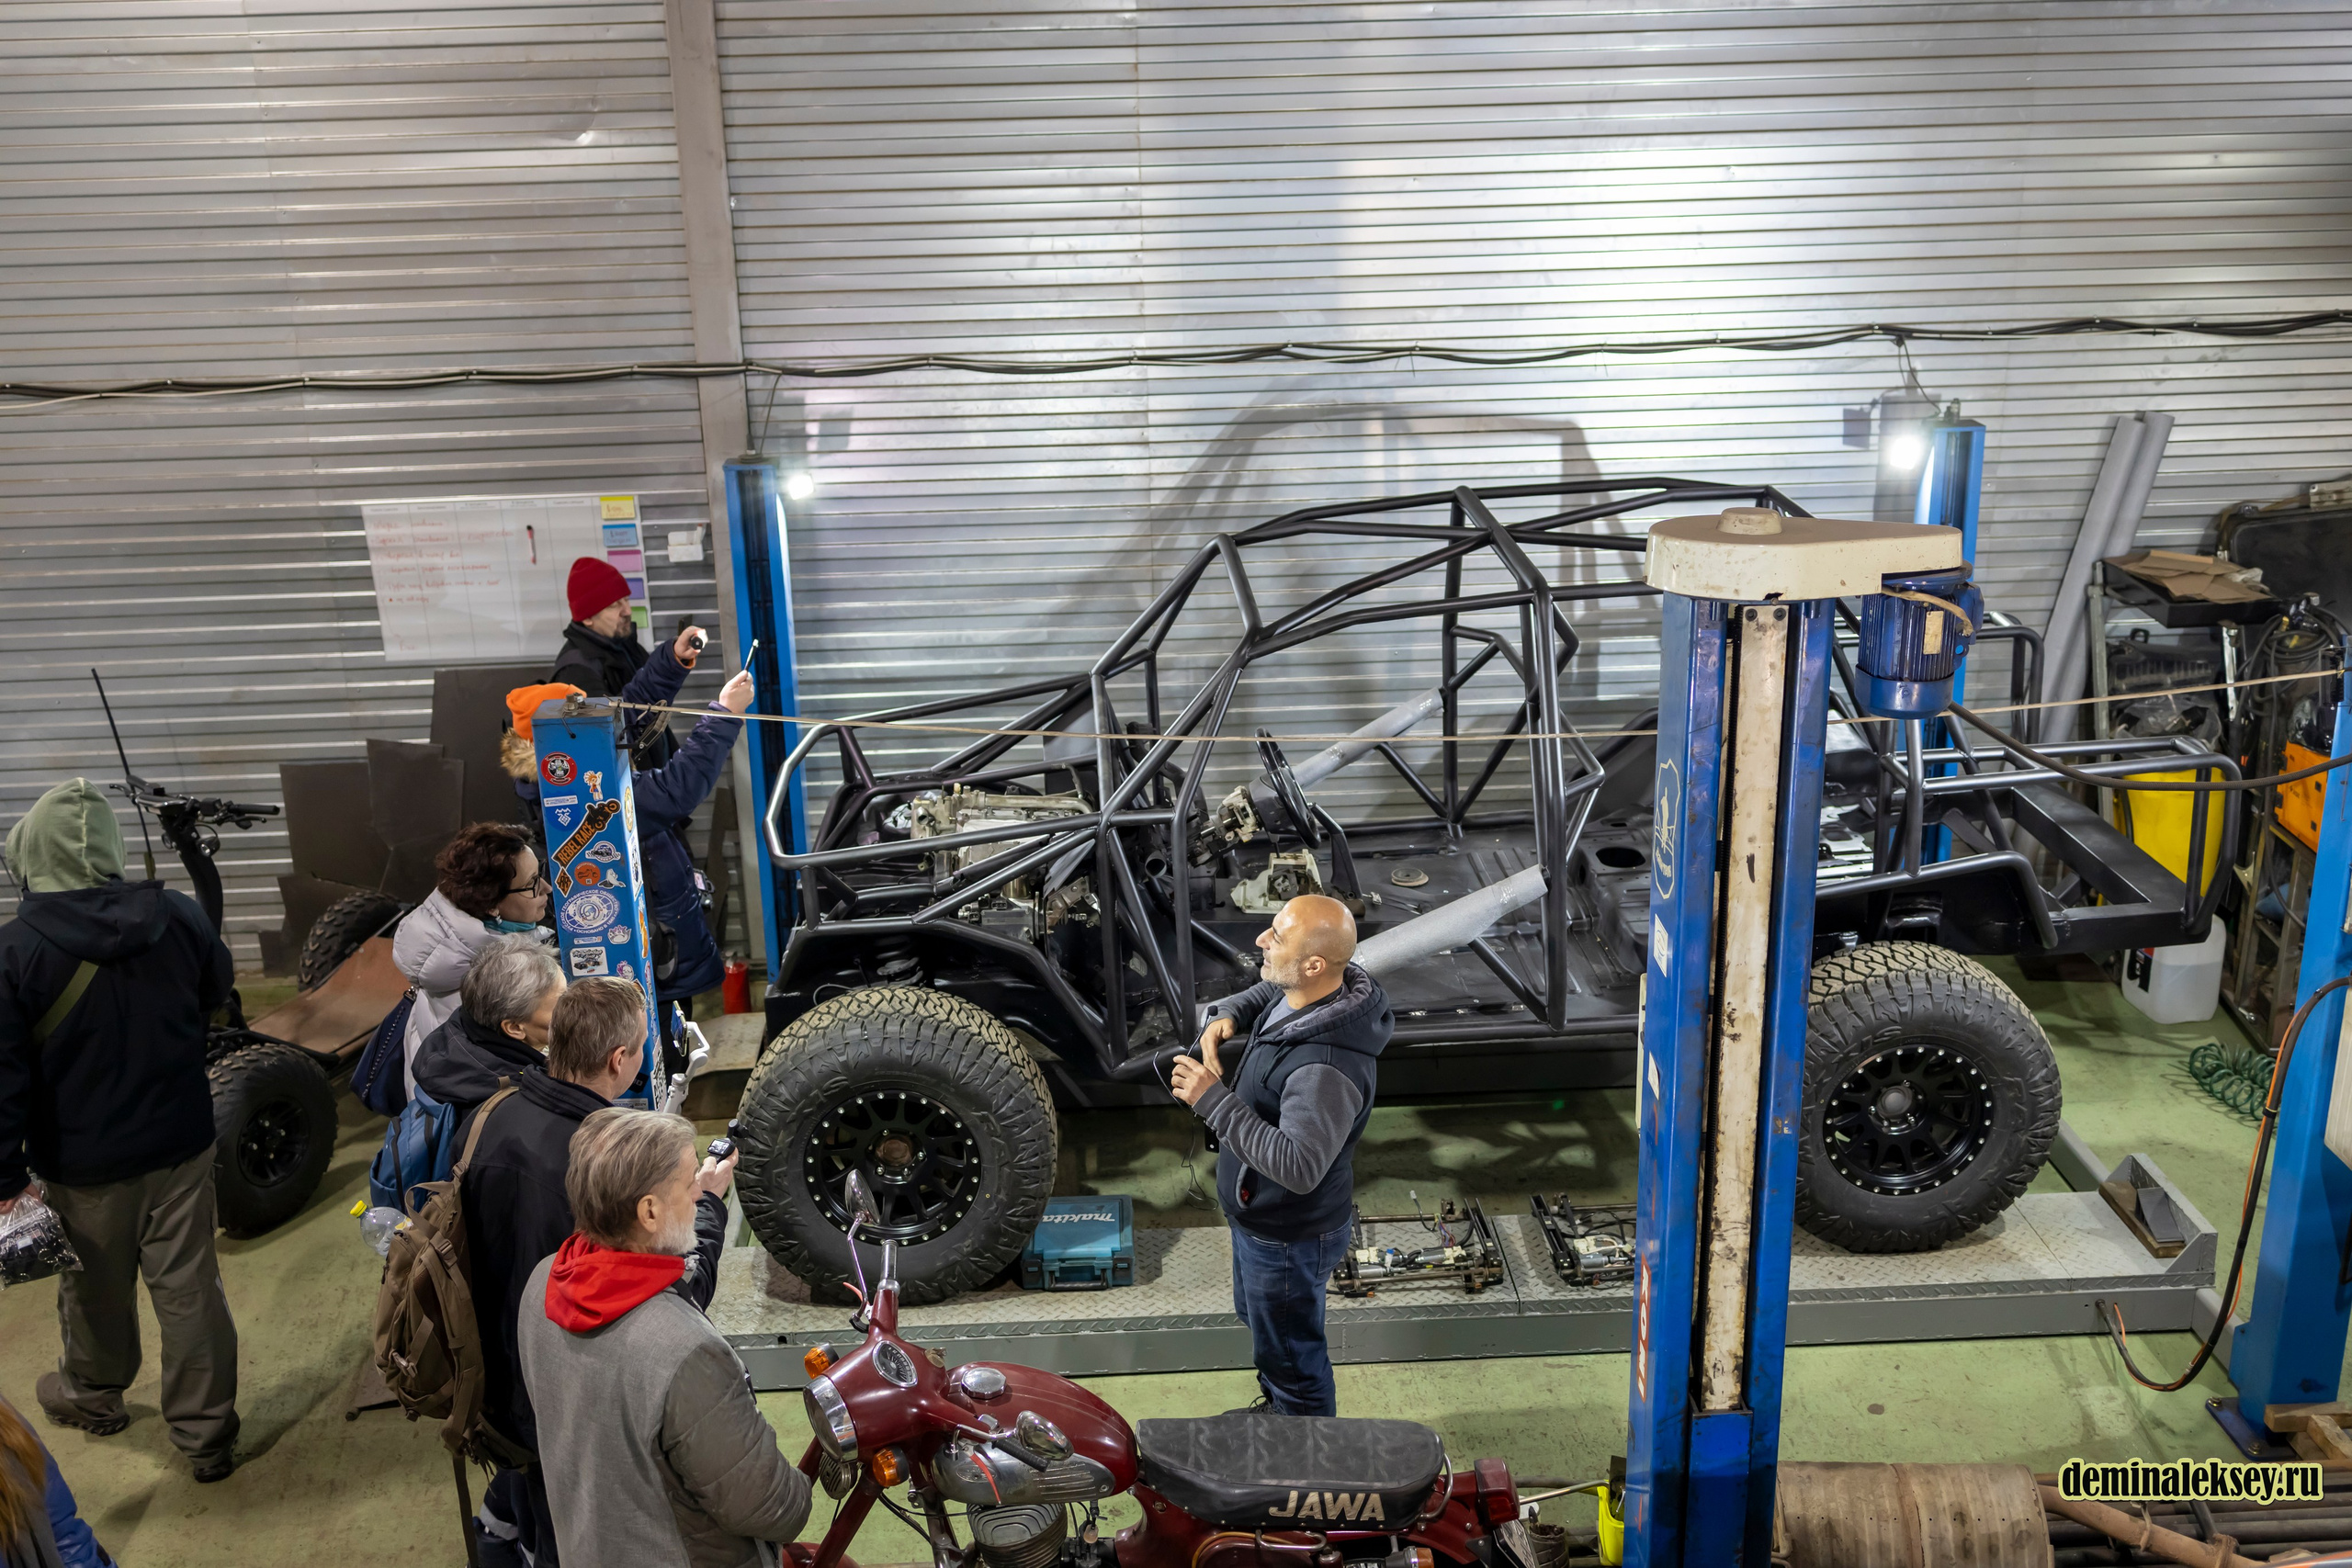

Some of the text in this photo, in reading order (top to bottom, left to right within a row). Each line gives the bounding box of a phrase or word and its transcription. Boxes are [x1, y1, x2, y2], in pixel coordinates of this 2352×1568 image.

[557, 820, 595, 864] REBEL RACE
[1638, 1265, 1649, 1398] KONI
[1268, 1490, 1386, 1521] JAWA
